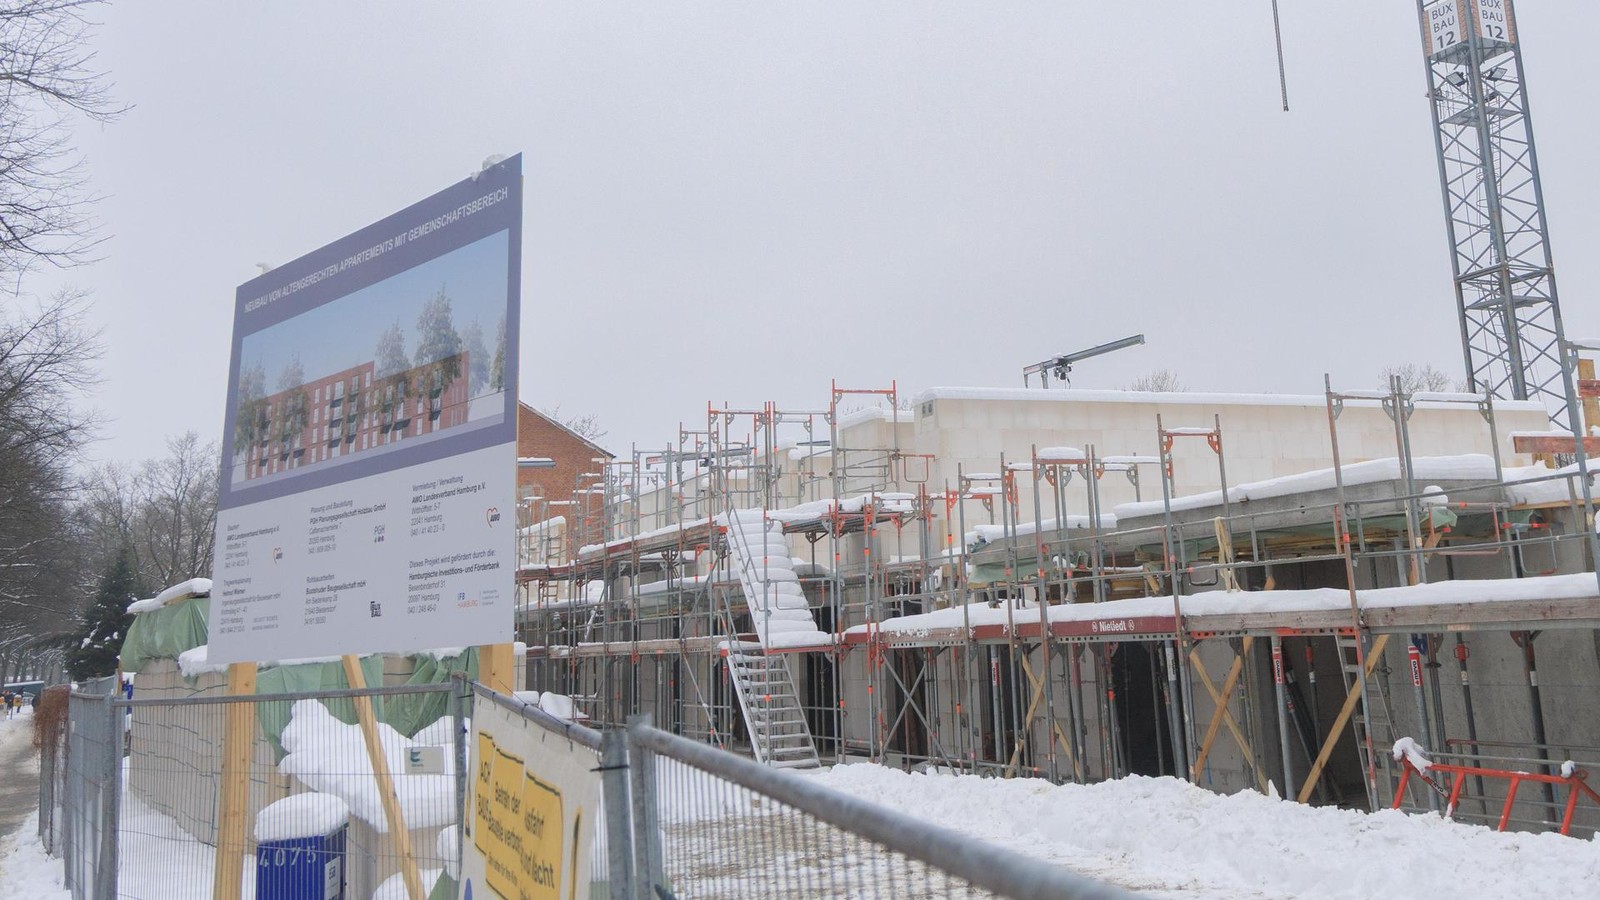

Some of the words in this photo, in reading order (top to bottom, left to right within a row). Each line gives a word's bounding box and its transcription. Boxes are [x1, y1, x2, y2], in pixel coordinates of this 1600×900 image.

[1482, 10, 1503, 22] BAU
[1433, 16, 1455, 33] BAU
[1486, 25, 1504, 39] 12
[1437, 31, 1456, 48] 12
[245, 295, 267, 312] NEUBAU
[268, 288, 281, 302] VON
[282, 263, 338, 296] ALTENGERECHTEN
[339, 239, 392, 271] APPARTEMENTS
[395, 233, 407, 247] MIT
[408, 188, 507, 242] GEMEINSCHAFTSBEREICH
[412, 496, 422, 504] AWO
[423, 489, 455, 501] Landesverband
[456, 485, 476, 496] Hamburg
[424, 514, 442, 525] Hamburg
[490, 514, 500, 522] AWO
[409, 560, 423, 568] Dieses
[424, 558, 439, 567] Projekt
[408, 570, 437, 582] Hamburgische
[465, 565, 473, 573] und
[474, 561, 499, 571] Förderbank
[1099, 620, 1127, 632] Nietiedt
